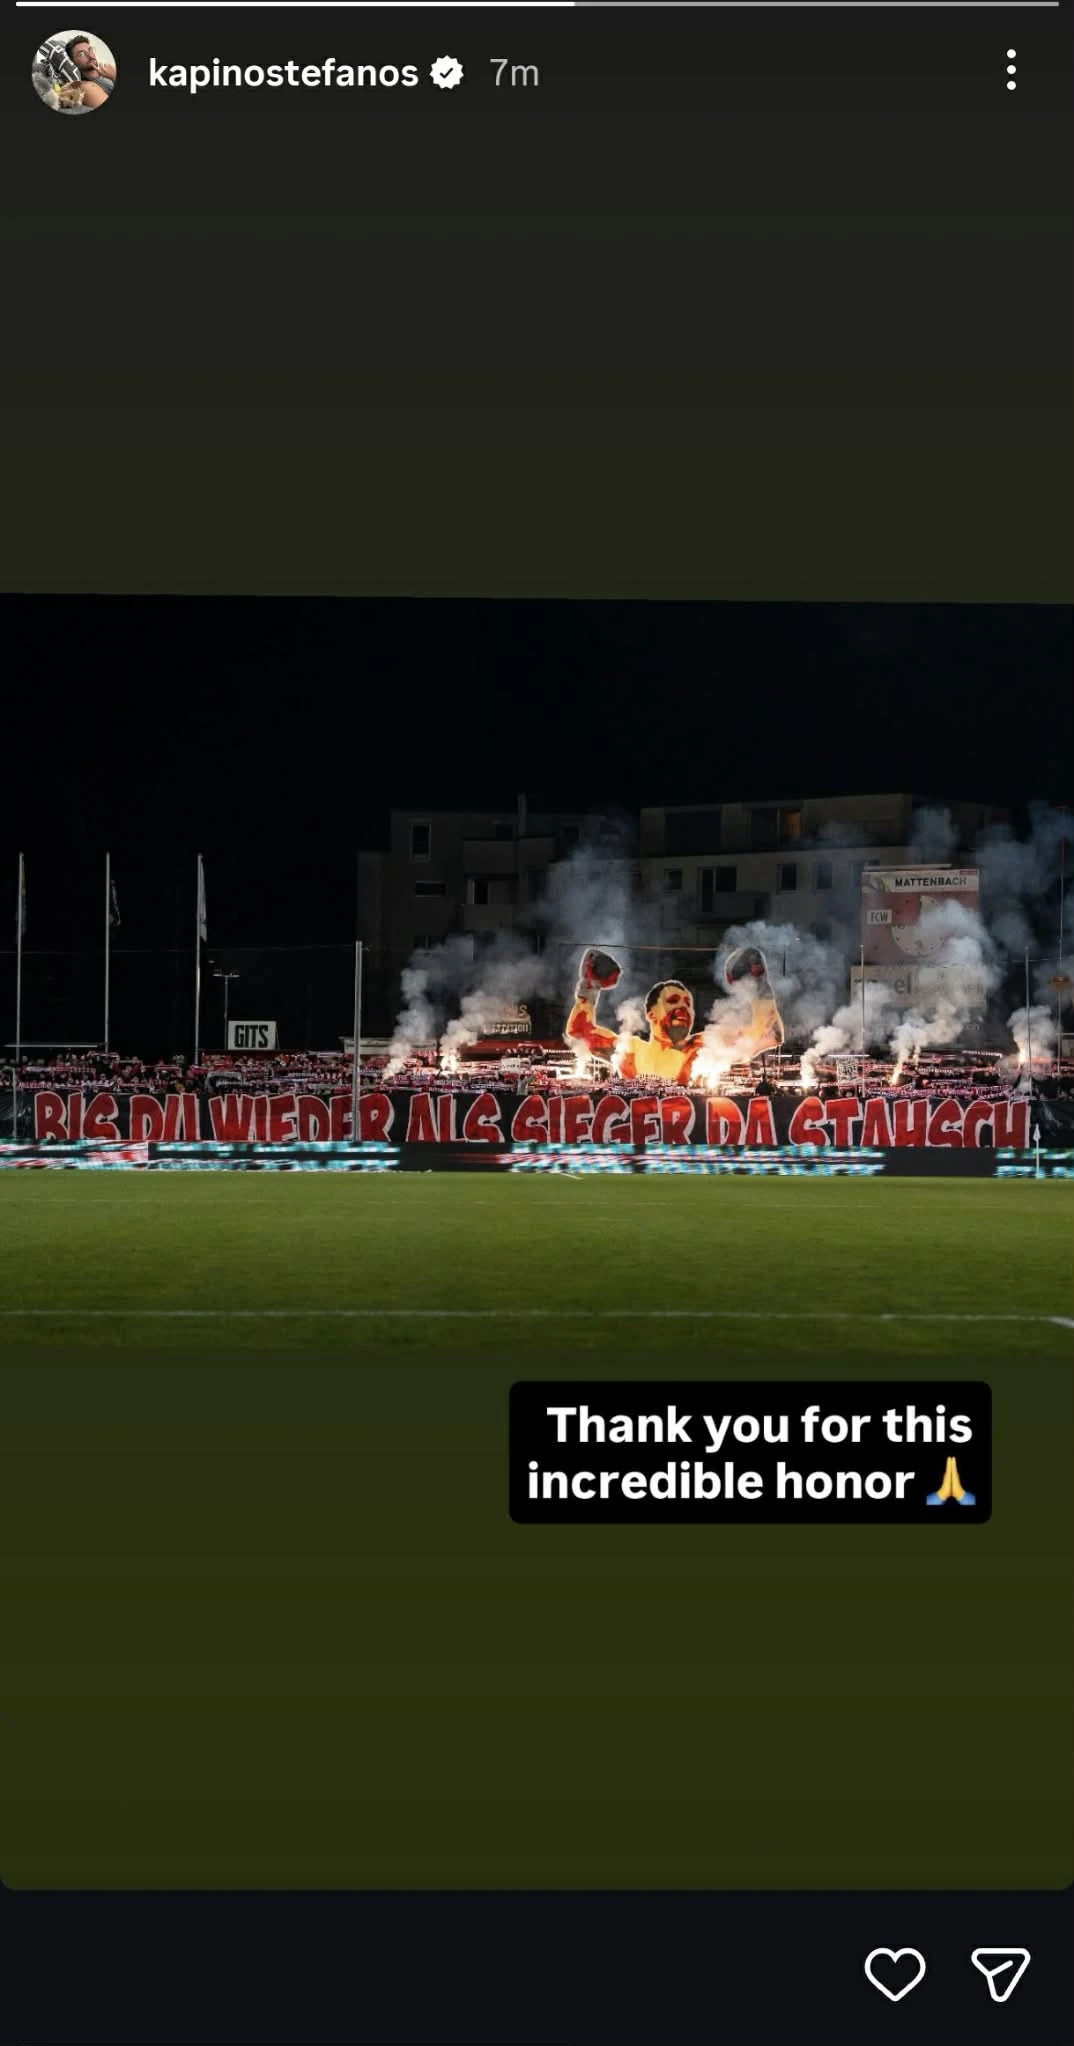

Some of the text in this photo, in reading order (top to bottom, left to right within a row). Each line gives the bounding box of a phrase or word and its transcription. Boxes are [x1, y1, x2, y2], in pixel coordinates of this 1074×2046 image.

[895, 876, 968, 887] MATTENBACH
[234, 1024, 269, 1048] GITS
[34, 1090, 121, 1141] BIS
[208, 1092, 396, 1143] WIEDER
[405, 1091, 505, 1144] ALS
[511, 1093, 696, 1146] SIEGER
[706, 1095, 778, 1147] DA
[788, 1095, 1031, 1148] STAHSCH
